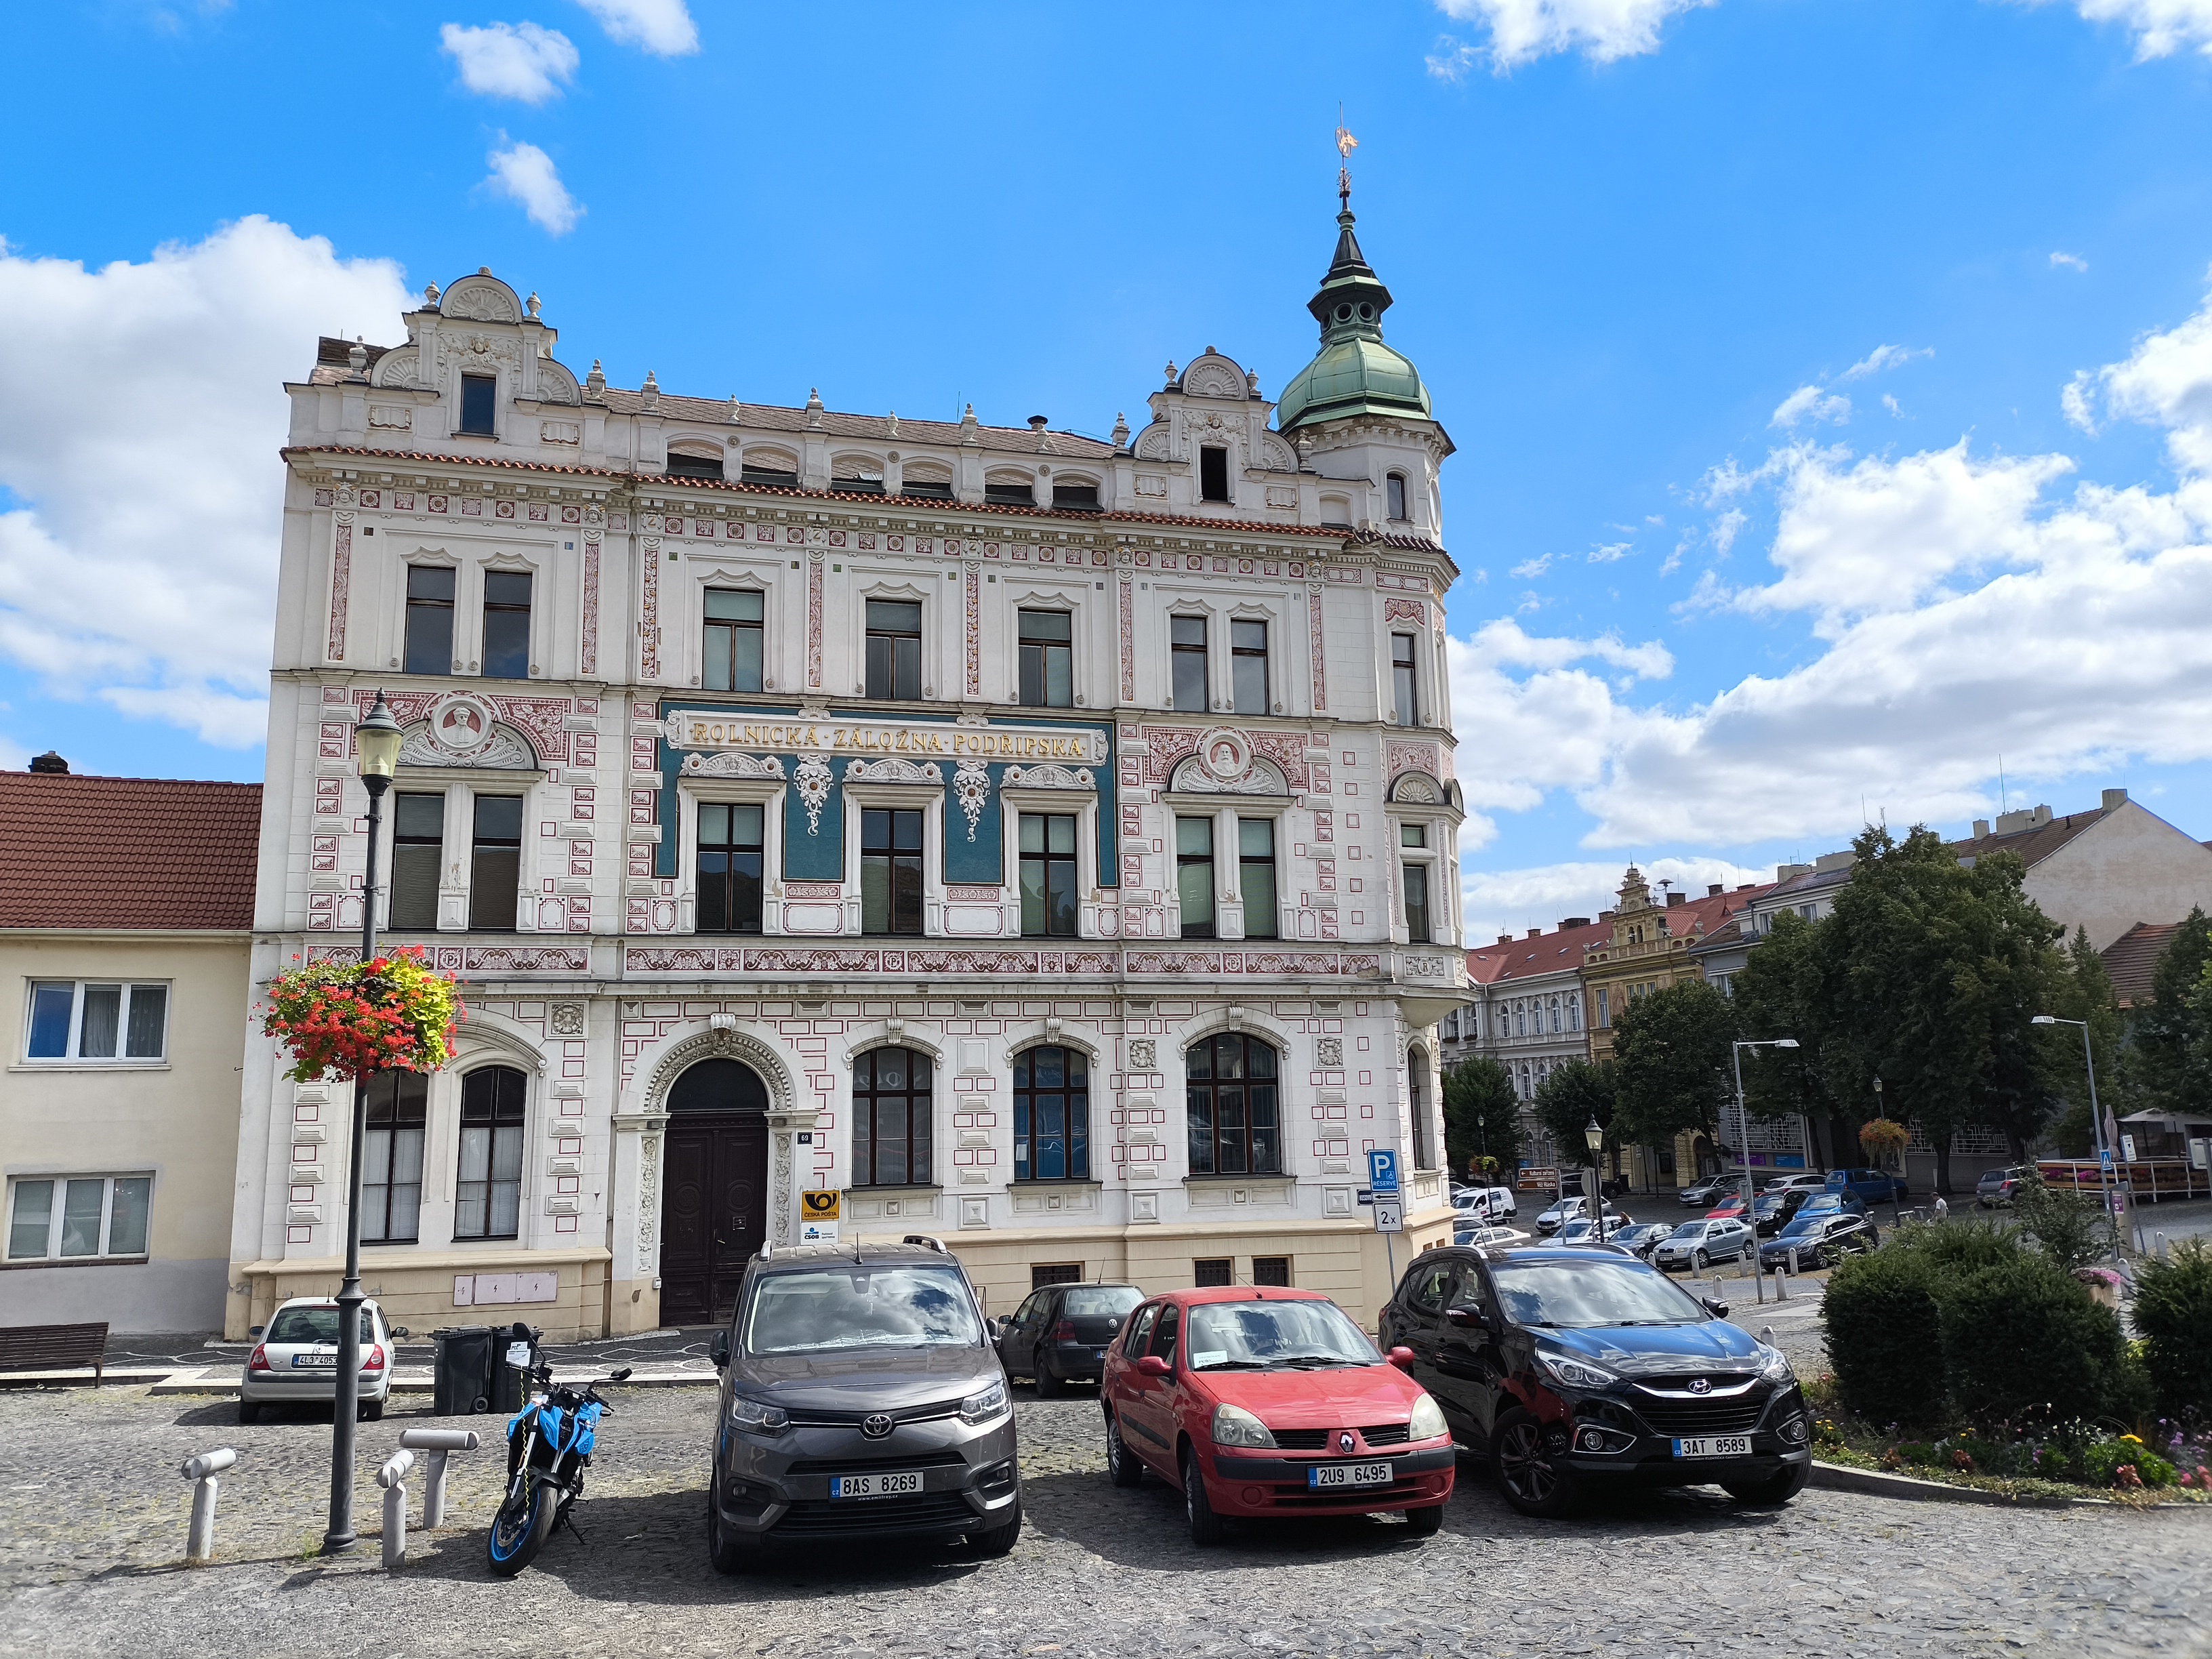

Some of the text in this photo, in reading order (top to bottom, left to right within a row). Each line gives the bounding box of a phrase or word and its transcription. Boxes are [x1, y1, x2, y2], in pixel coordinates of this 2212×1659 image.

[693, 722, 1083, 756] ROLNICKÁ ZÁLOŽNA PODŘIPSKÁ
[1374, 1155, 1390, 1179] P
[300, 1356, 314, 1364] 4L3
[1683, 1438, 1746, 1454] 3AT 8589
[1319, 1465, 1387, 1484] 2U9 6495
[843, 1475, 917, 1494] 8AS 8269
